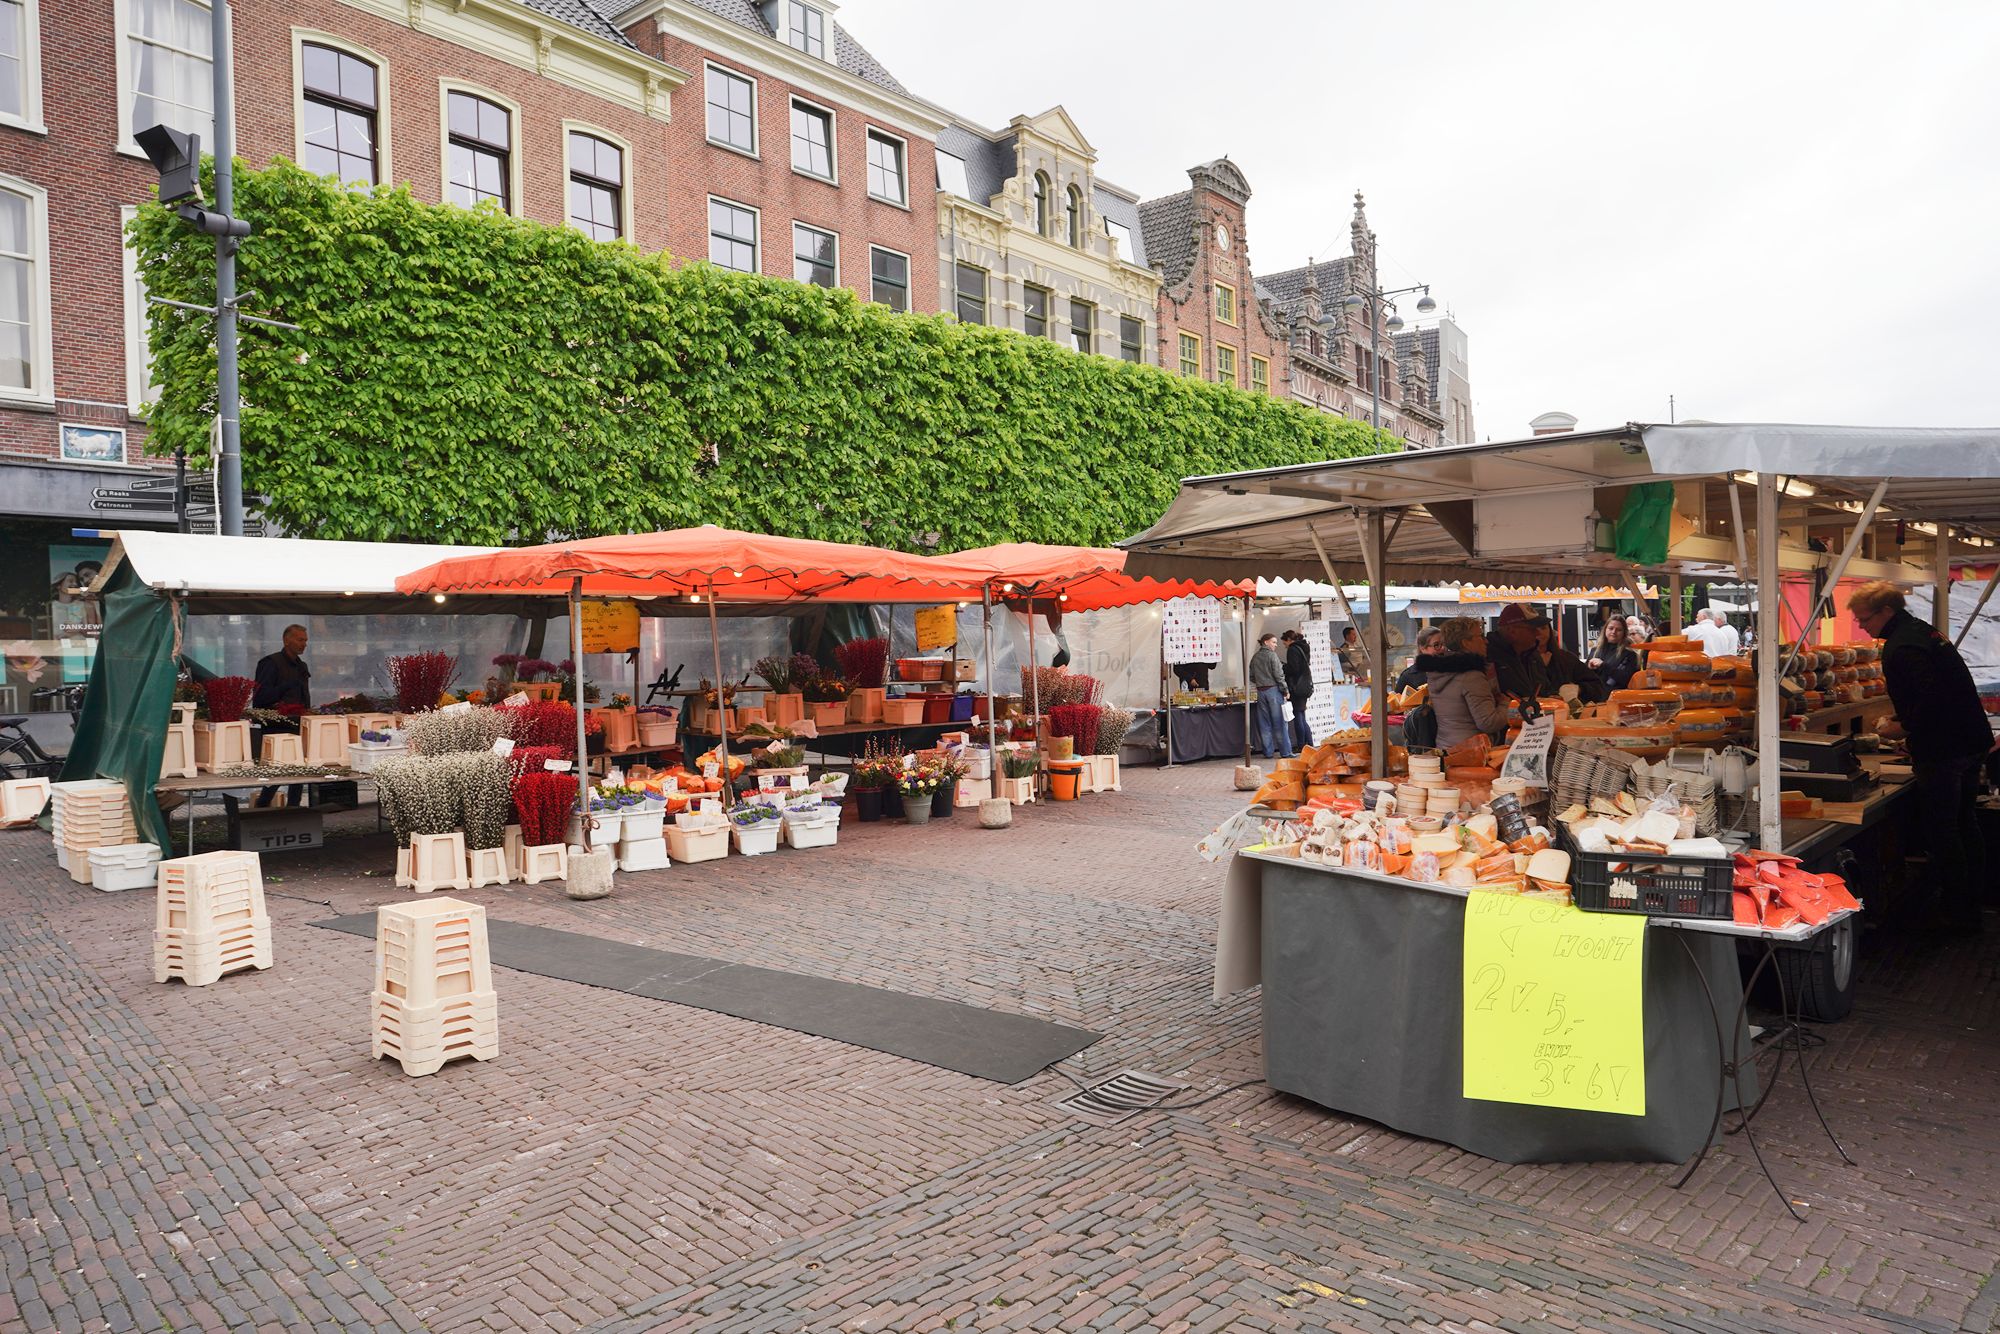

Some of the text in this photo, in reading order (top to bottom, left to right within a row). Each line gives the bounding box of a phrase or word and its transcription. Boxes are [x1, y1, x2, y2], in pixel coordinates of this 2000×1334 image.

[260, 833, 312, 848] TIPS
[1473, 963, 1506, 1011] 2
[1532, 1059, 1555, 1098] 3
